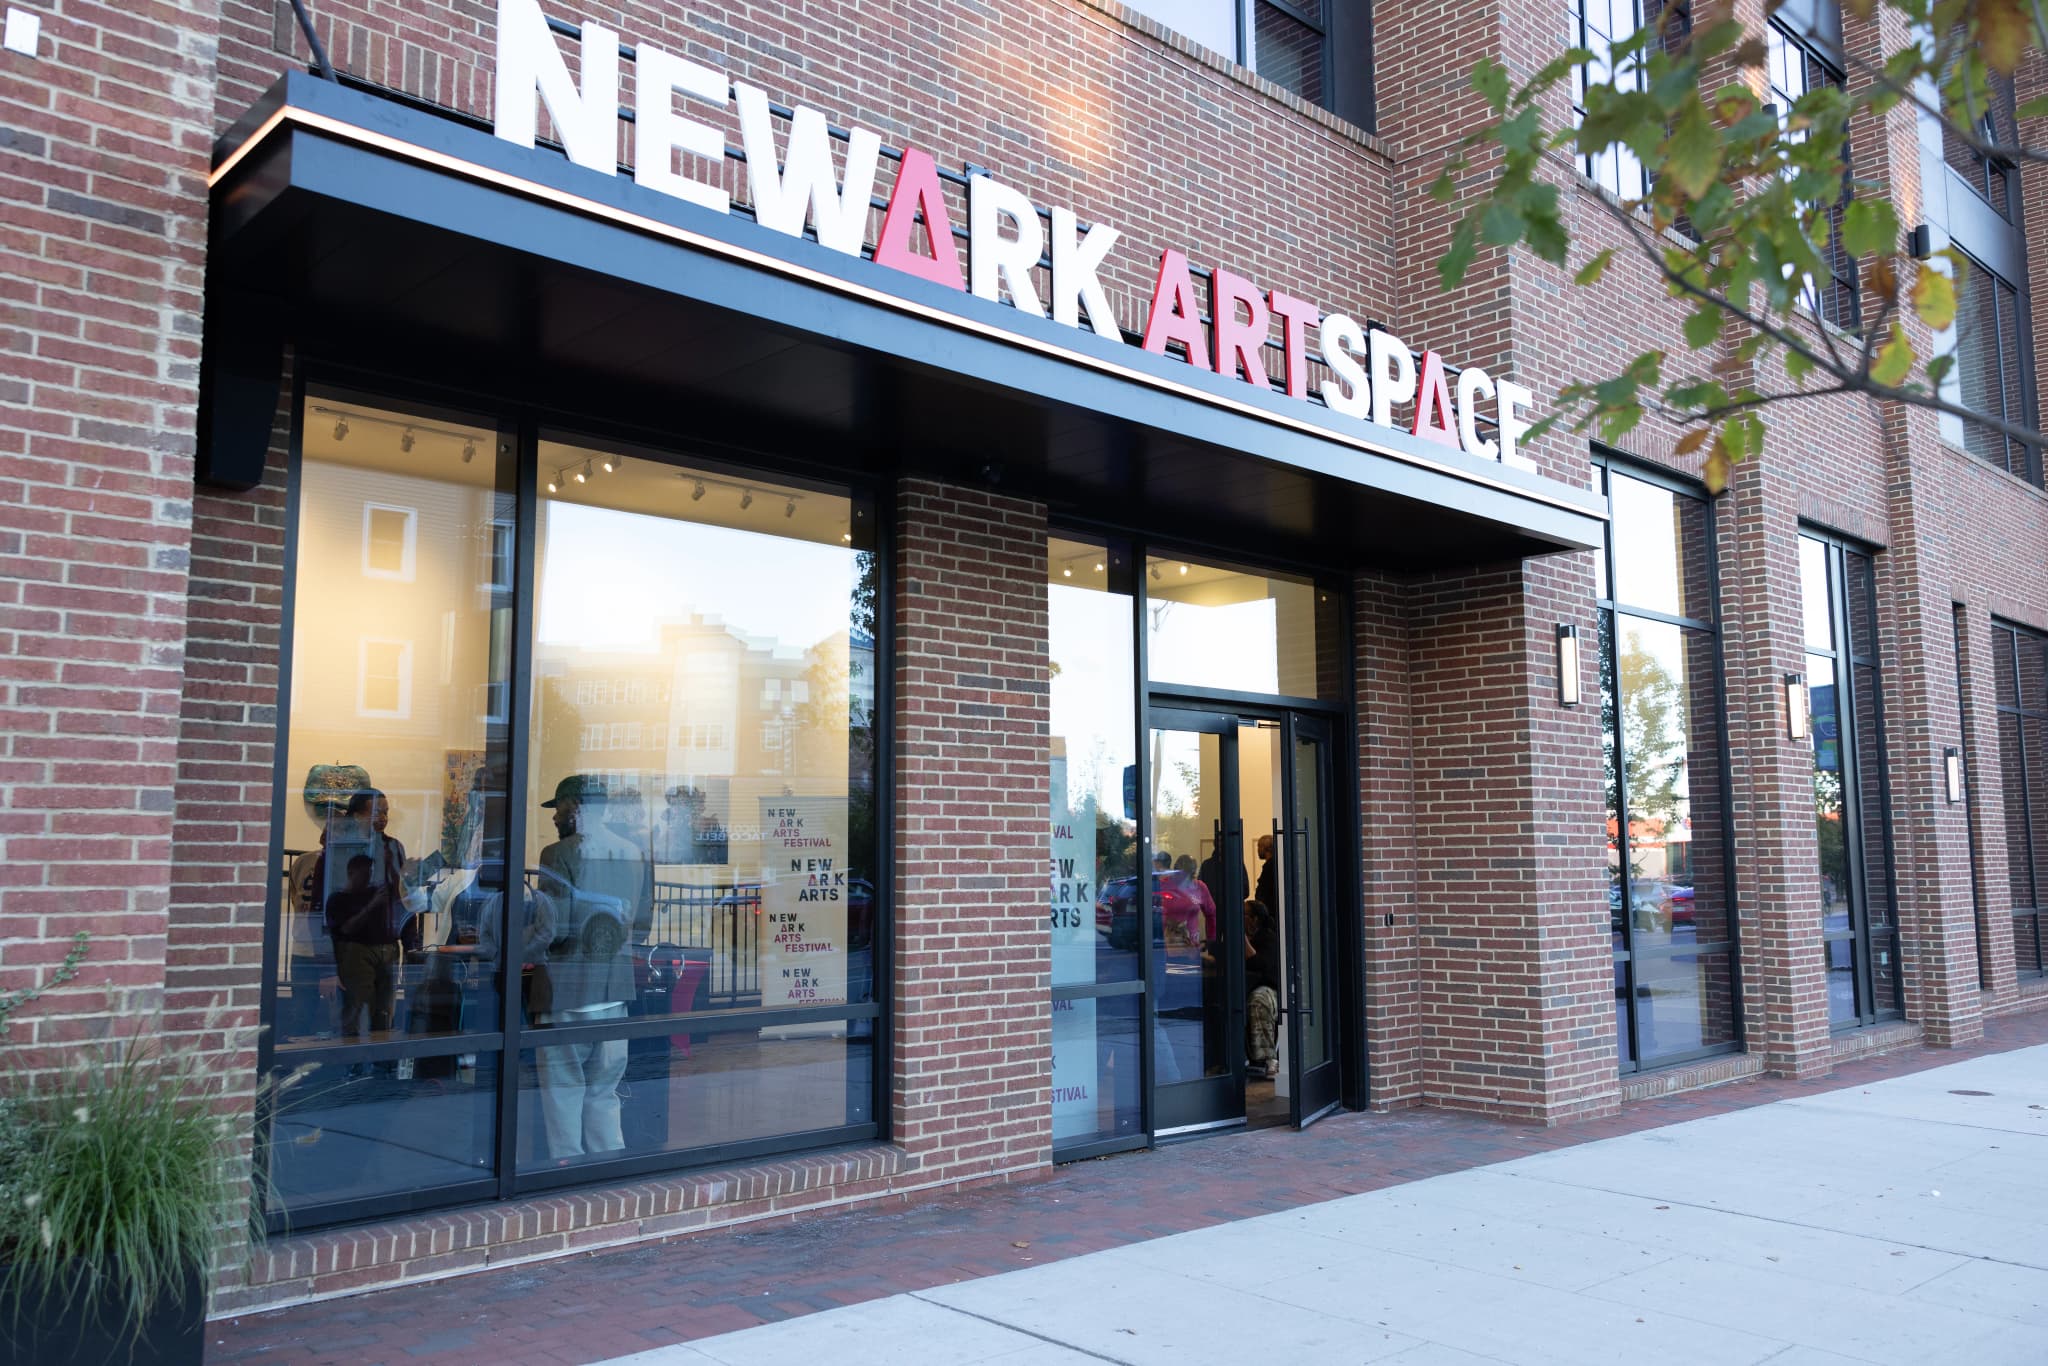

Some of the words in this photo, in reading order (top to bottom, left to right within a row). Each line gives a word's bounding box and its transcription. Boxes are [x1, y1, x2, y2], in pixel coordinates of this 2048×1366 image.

[494, 0, 1125, 344] NEWARK
[772, 829, 800, 838] ARTS
[784, 838, 832, 848] FESTIVAL
[798, 888, 839, 902] ARTS
[1050, 883, 1089, 903] RK
[1051, 907, 1081, 928] RTS
[774, 933, 802, 943] ARTS
[785, 943, 833, 952] FESTIVAL
[787, 988, 815, 999] ARTS
